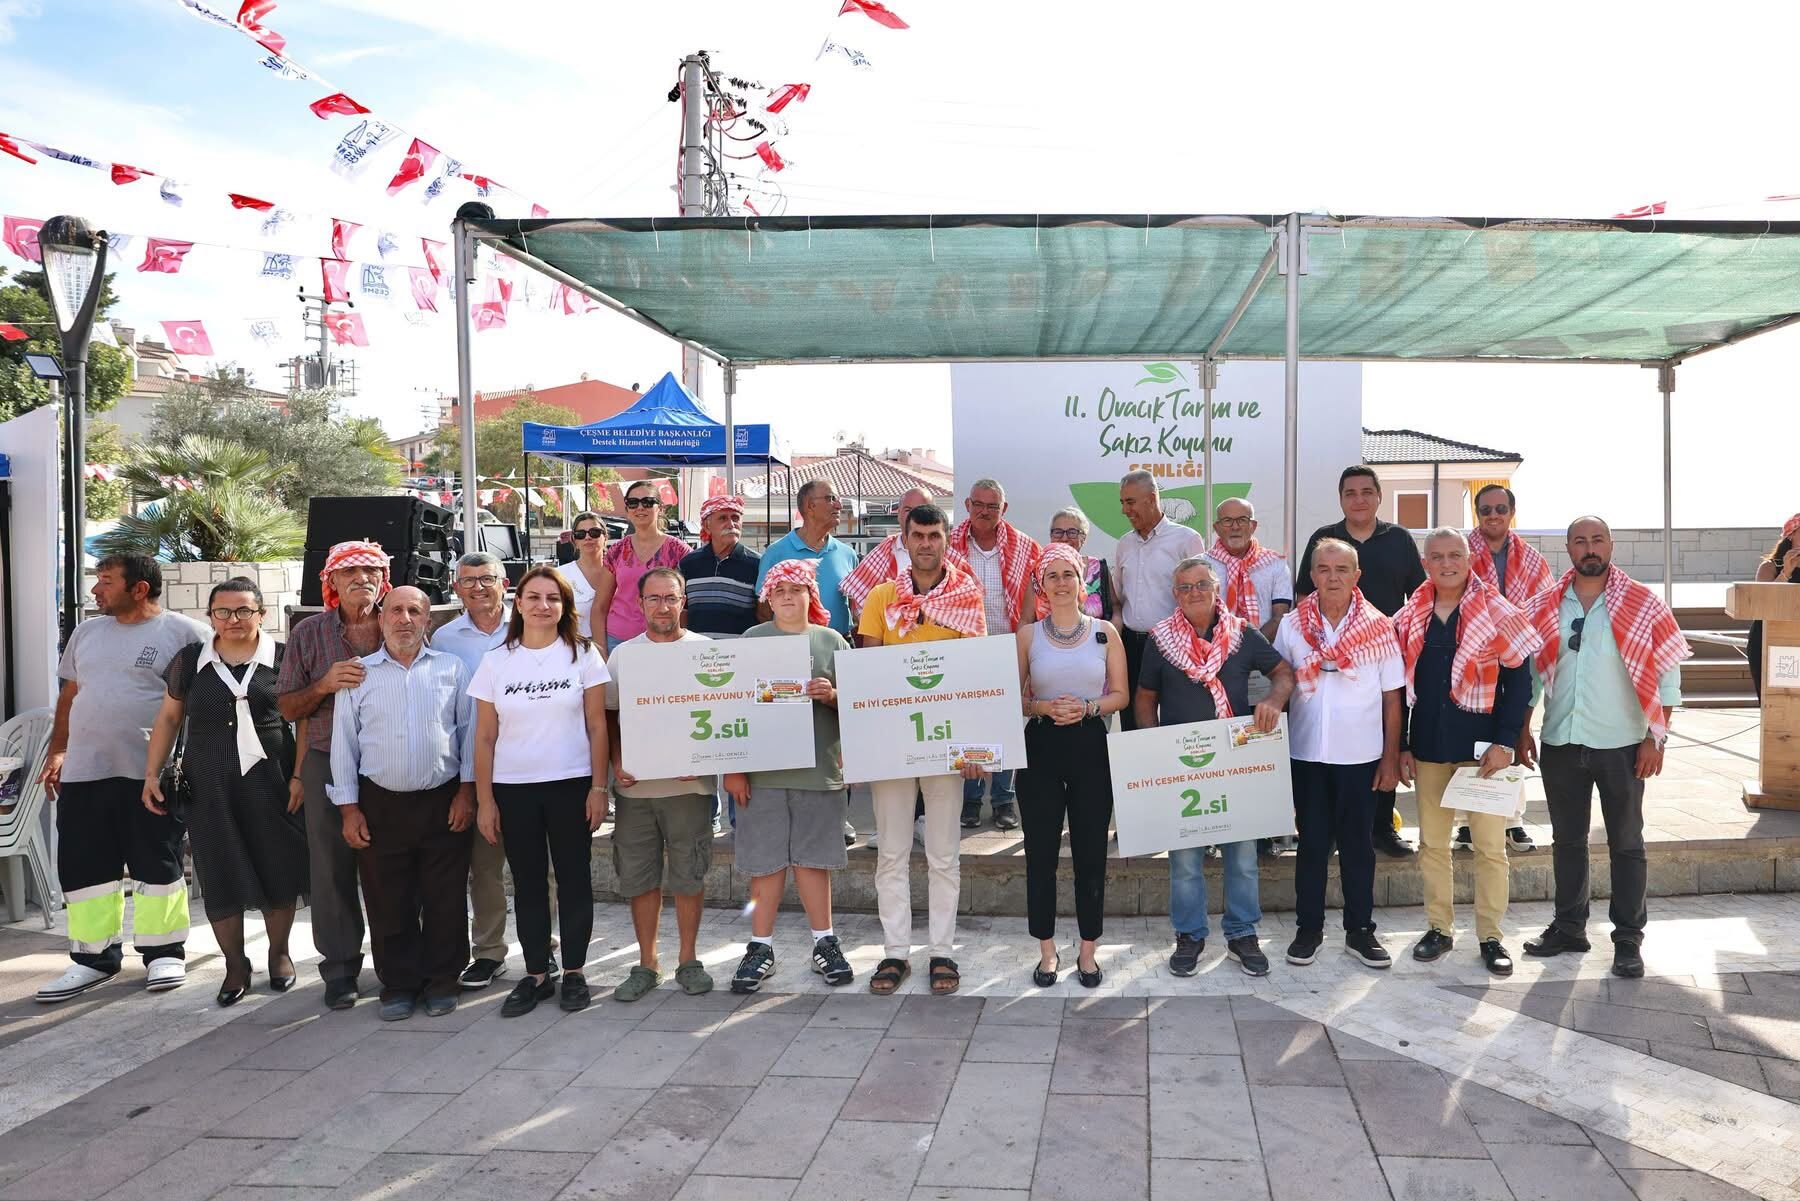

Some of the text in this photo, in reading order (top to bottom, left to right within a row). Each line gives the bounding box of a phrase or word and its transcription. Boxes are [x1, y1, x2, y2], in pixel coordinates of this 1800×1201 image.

[1099, 386, 1166, 424] Ovacık
[1165, 388, 1231, 420] Tarm
[1237, 401, 1262, 419] ve
[579, 428, 711, 438] ÇEŞME BELEDİYE BAŞKANLIĞI
[592, 438, 701, 448] Destek Hizmetleri Müdürlüğü
[1099, 424, 1153, 457] Sakız
[636, 697, 650, 705] EN
[652, 694, 665, 705] İYİ
[667, 694, 700, 704] ÇEŞME
[702, 691, 744, 701] KAVUNU
[853, 688, 1005, 709] EN İYİ ÇEŞME KAVUNU YARIŞMASI
[689, 710, 749, 741] 3.sü
[909, 712, 952, 742] 1.si
[1127, 763, 1275, 790] EN İYİ ÇEŞME KAVUNU YARIŞMASI
[1179, 788, 1228, 818] 2.si
